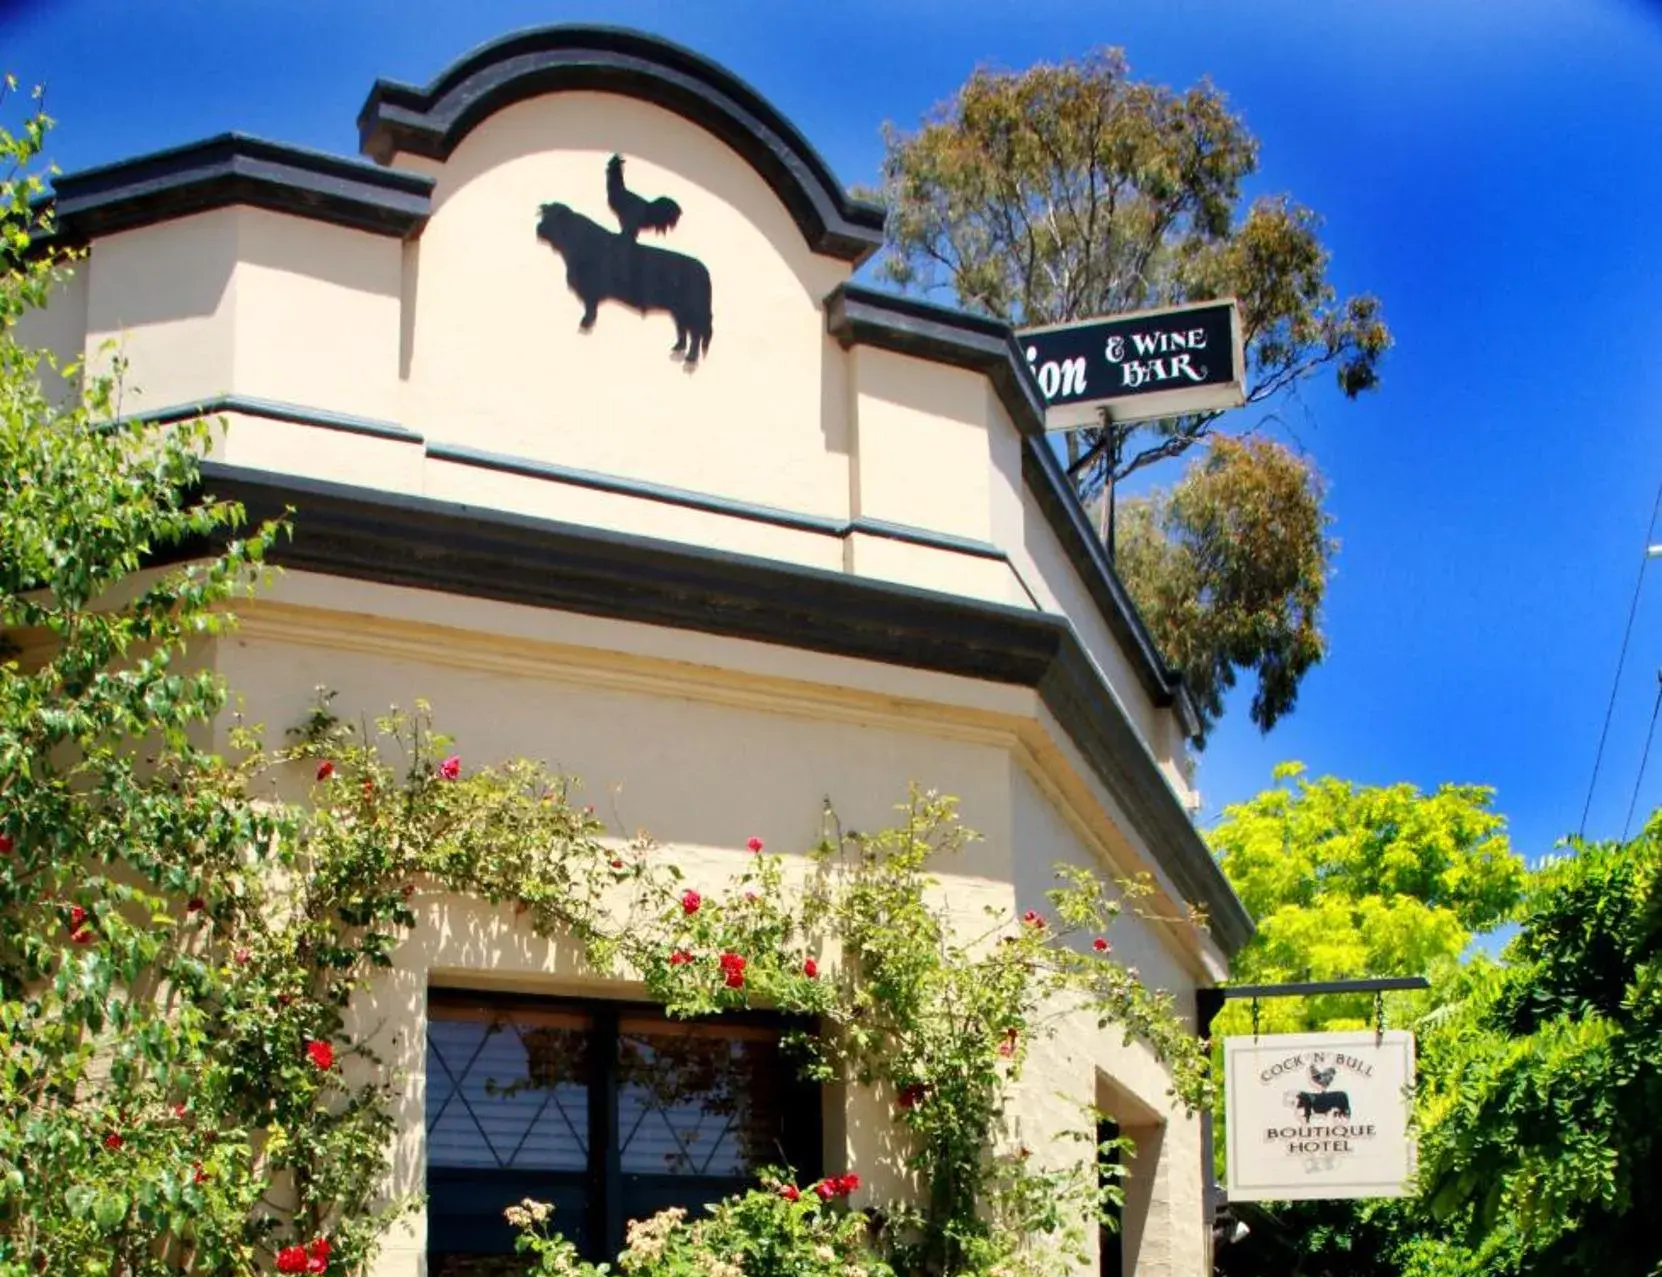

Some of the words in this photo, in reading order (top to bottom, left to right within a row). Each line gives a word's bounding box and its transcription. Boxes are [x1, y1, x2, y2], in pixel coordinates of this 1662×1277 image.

[1105, 335, 1125, 363] &
[1132, 328, 1208, 356] WINE
[1121, 353, 1208, 387] BAR
[1260, 1055, 1304, 1081] COCK
[1336, 1053, 1374, 1077] BULL
[1266, 1124, 1377, 1140] BOUTIQUE
[1289, 1140, 1353, 1154] HOTEL
